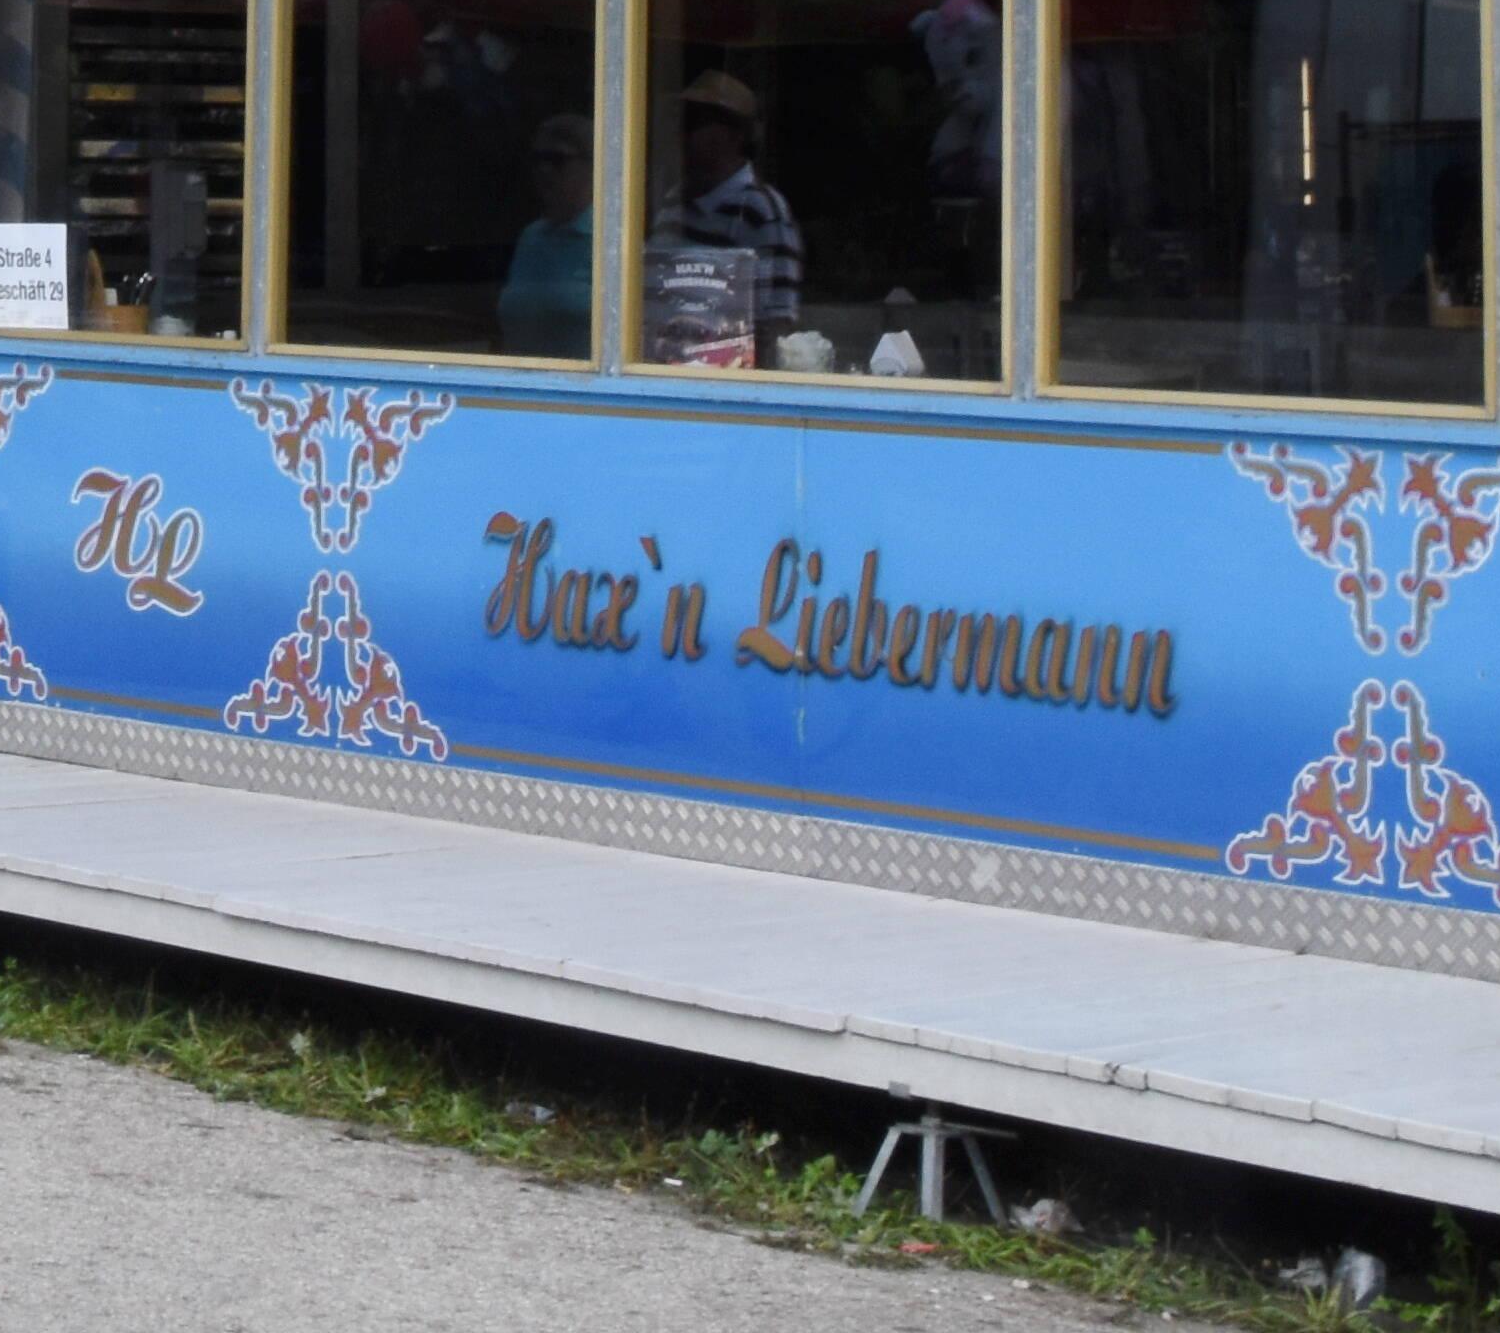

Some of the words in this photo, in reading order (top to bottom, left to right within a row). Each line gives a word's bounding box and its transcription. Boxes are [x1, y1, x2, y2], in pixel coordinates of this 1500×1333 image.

[44, 247, 52, 268] 4
[49, 280, 64, 301] 29
[736, 538, 1178, 719] Liebermann
